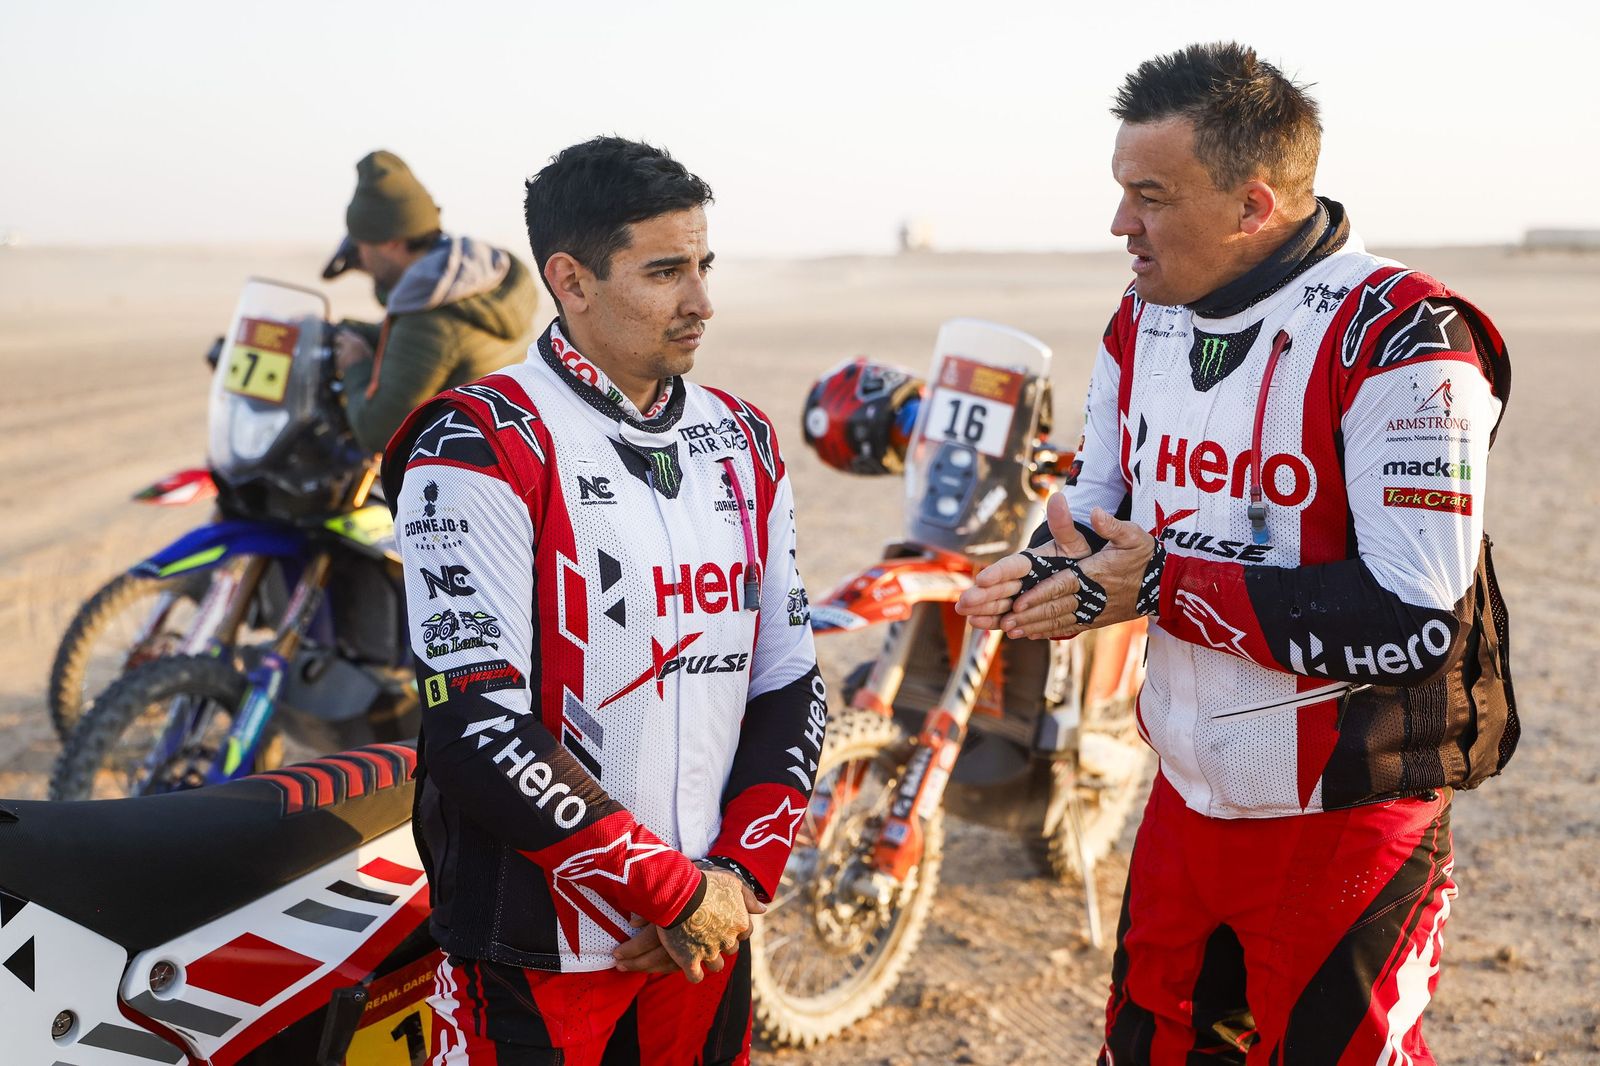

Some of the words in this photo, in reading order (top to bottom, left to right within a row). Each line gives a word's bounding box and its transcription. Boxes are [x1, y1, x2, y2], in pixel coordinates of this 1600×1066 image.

[242, 352, 260, 388] 7
[678, 422, 717, 441] TECH
[943, 400, 987, 443] 16
[1386, 417, 1471, 431] ARMSTRONG
[689, 438, 720, 457] AIR
[720, 434, 748, 450] BAG
[577, 475, 615, 499] NC
[1156, 434, 1311, 507] Hero
[1385, 488, 1422, 504] Tork
[1424, 492, 1470, 508] Craft
[420, 565, 477, 600] NC
[1344, 619, 1451, 675] Hero
[430, 680, 441, 702] 8
[492, 736, 587, 829] Hero
[364, 988, 402, 1011] REAM.
[403, 970, 436, 992] DARE.
